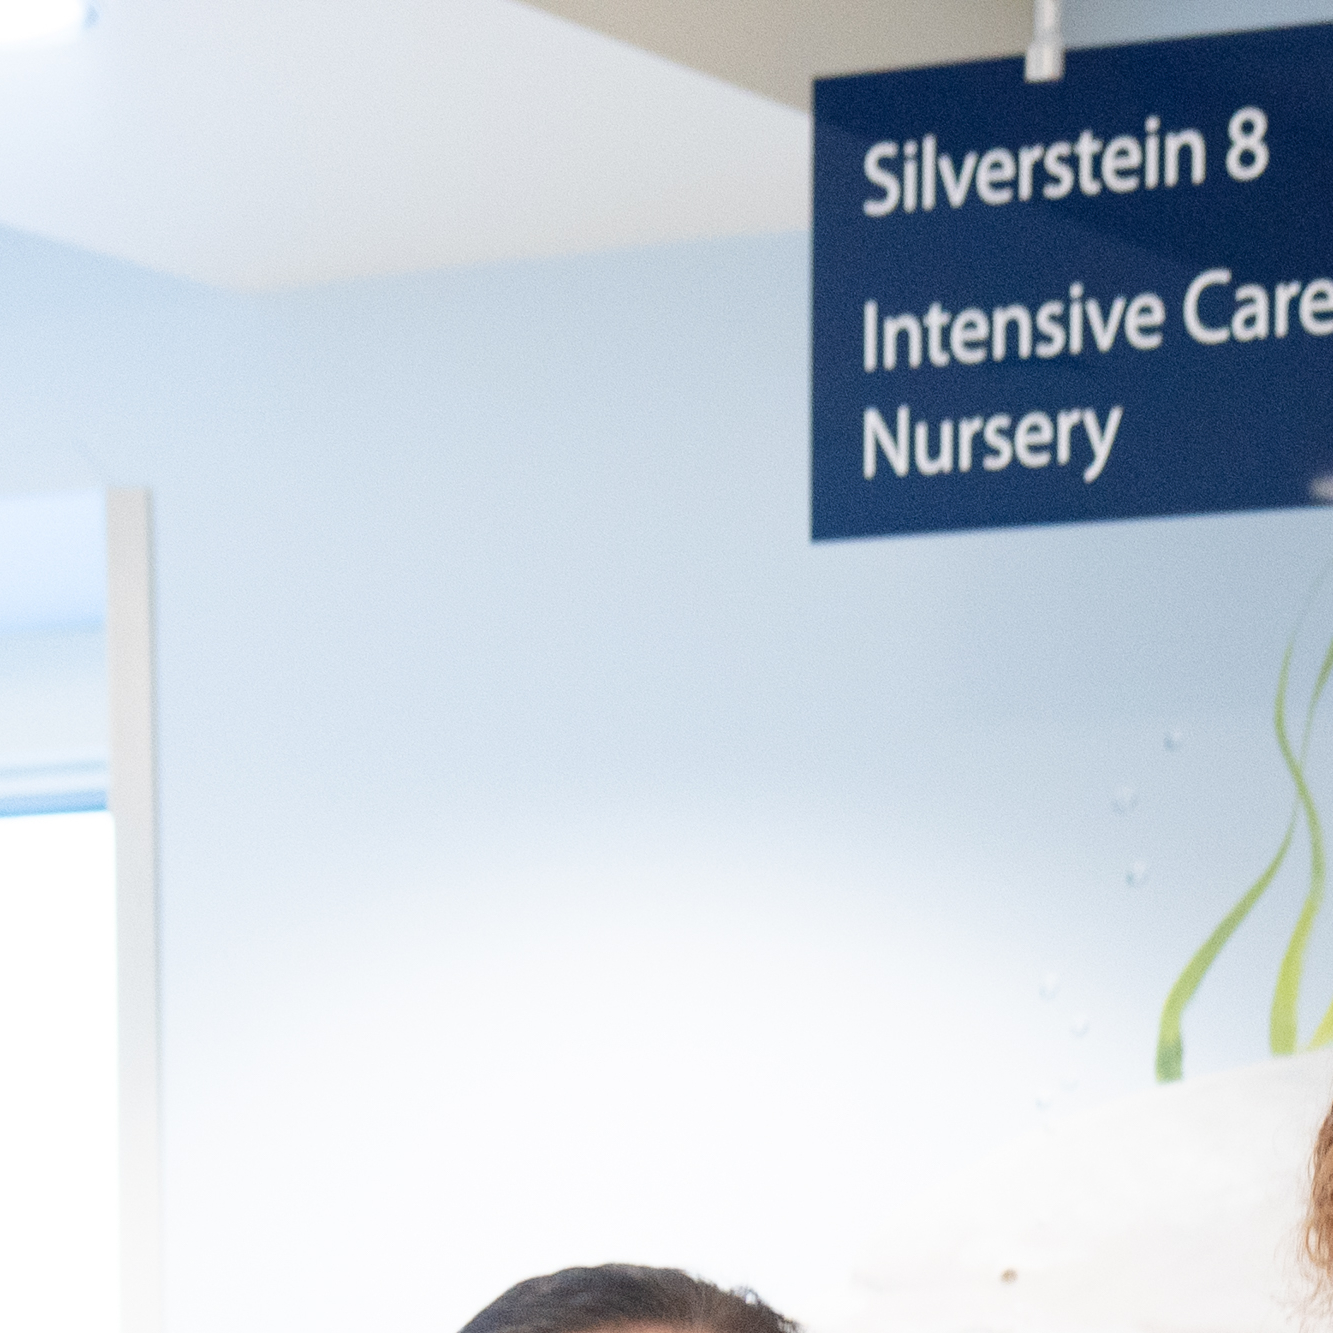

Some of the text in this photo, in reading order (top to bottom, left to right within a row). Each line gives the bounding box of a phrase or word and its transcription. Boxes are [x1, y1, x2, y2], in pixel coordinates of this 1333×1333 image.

[863, 107, 1269, 217] Silverstein 8
[863, 282, 1166, 372] Intensive
[863, 405, 1123, 483] Nursery
